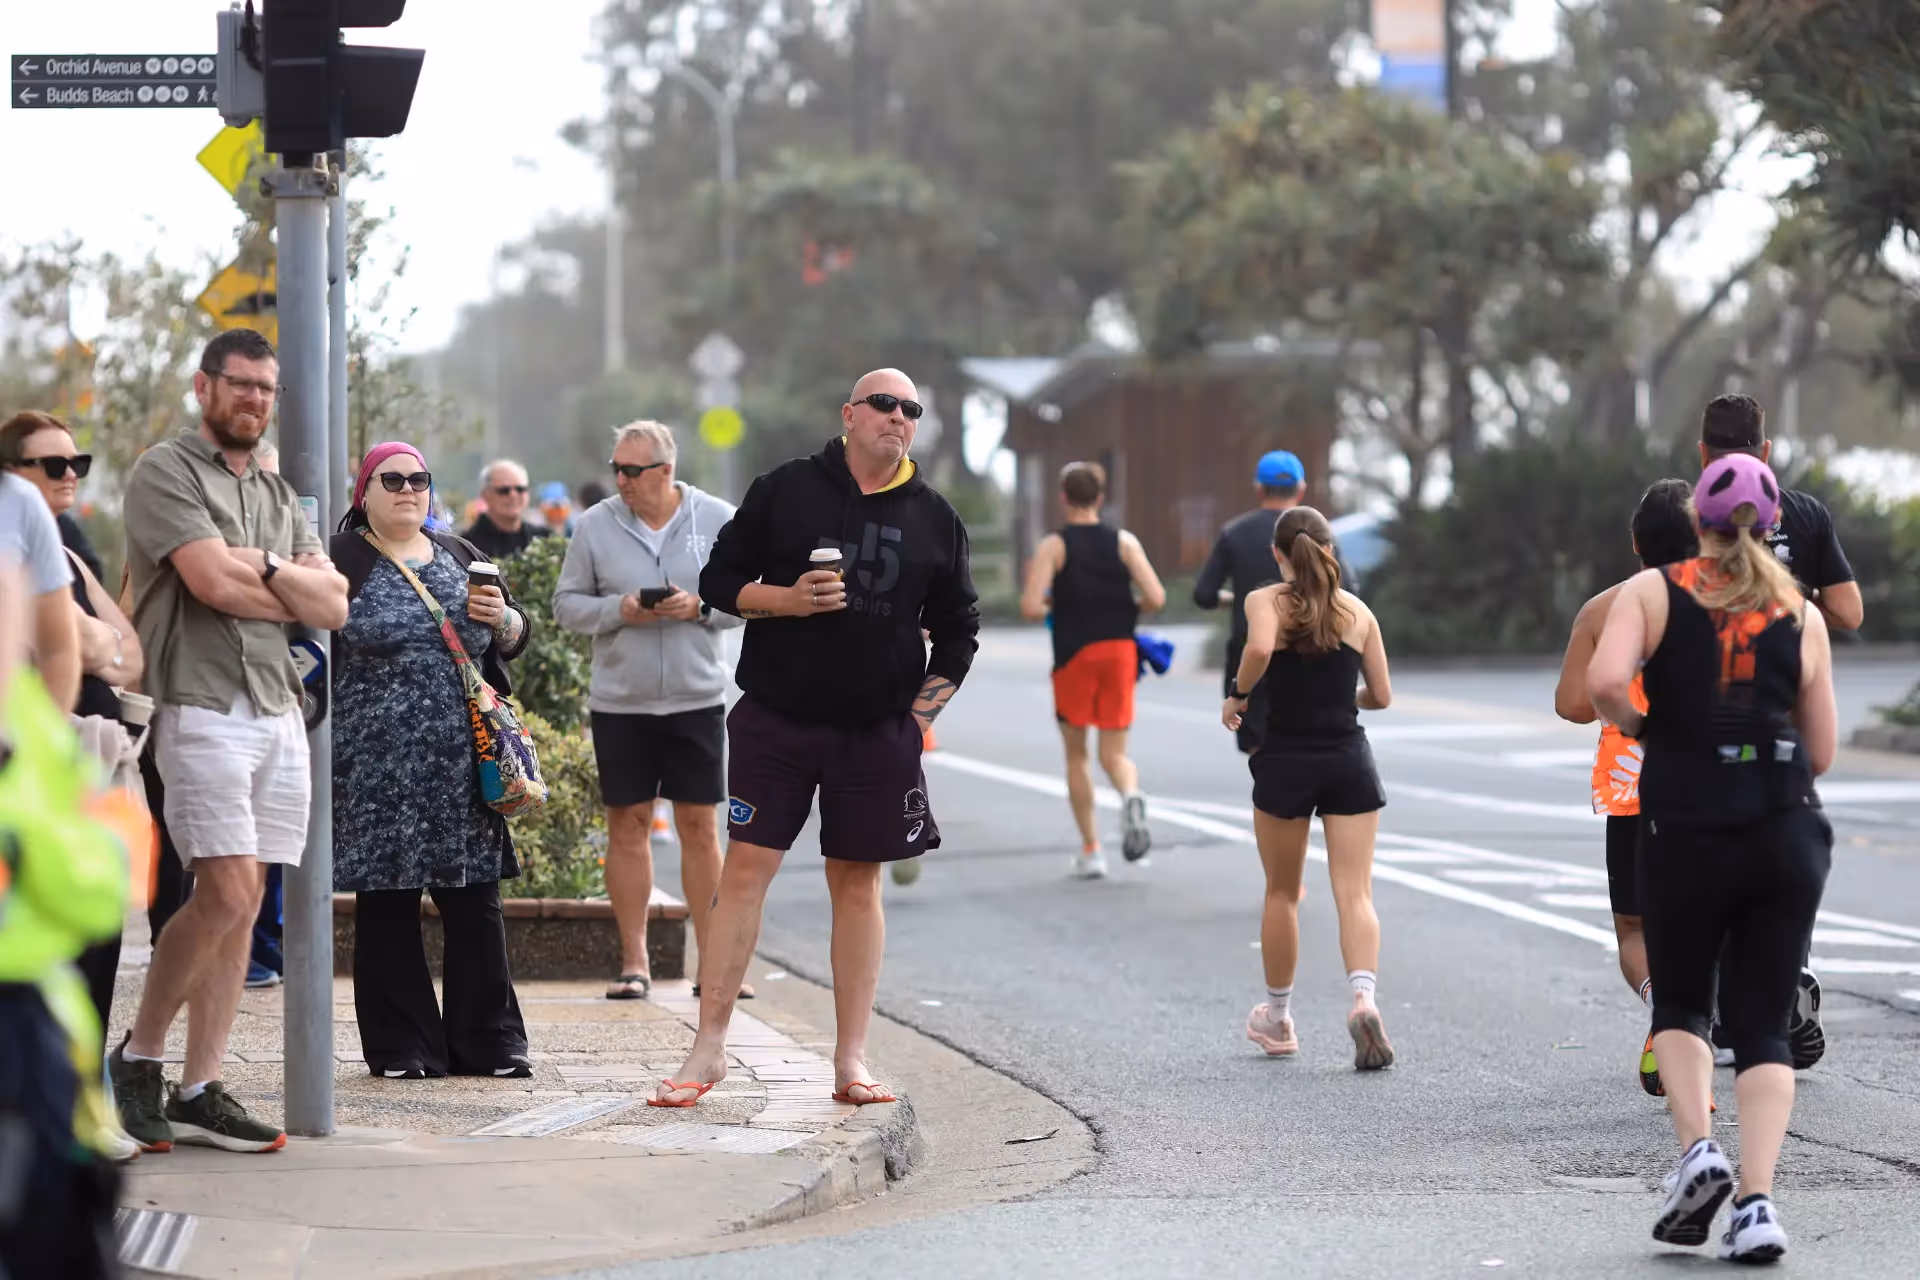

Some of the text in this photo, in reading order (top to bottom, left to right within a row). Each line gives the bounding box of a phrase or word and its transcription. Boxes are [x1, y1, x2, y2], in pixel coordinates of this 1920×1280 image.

[46, 58, 142, 75] Orchid Avenue
[46, 87, 134, 103] Budds Beach
